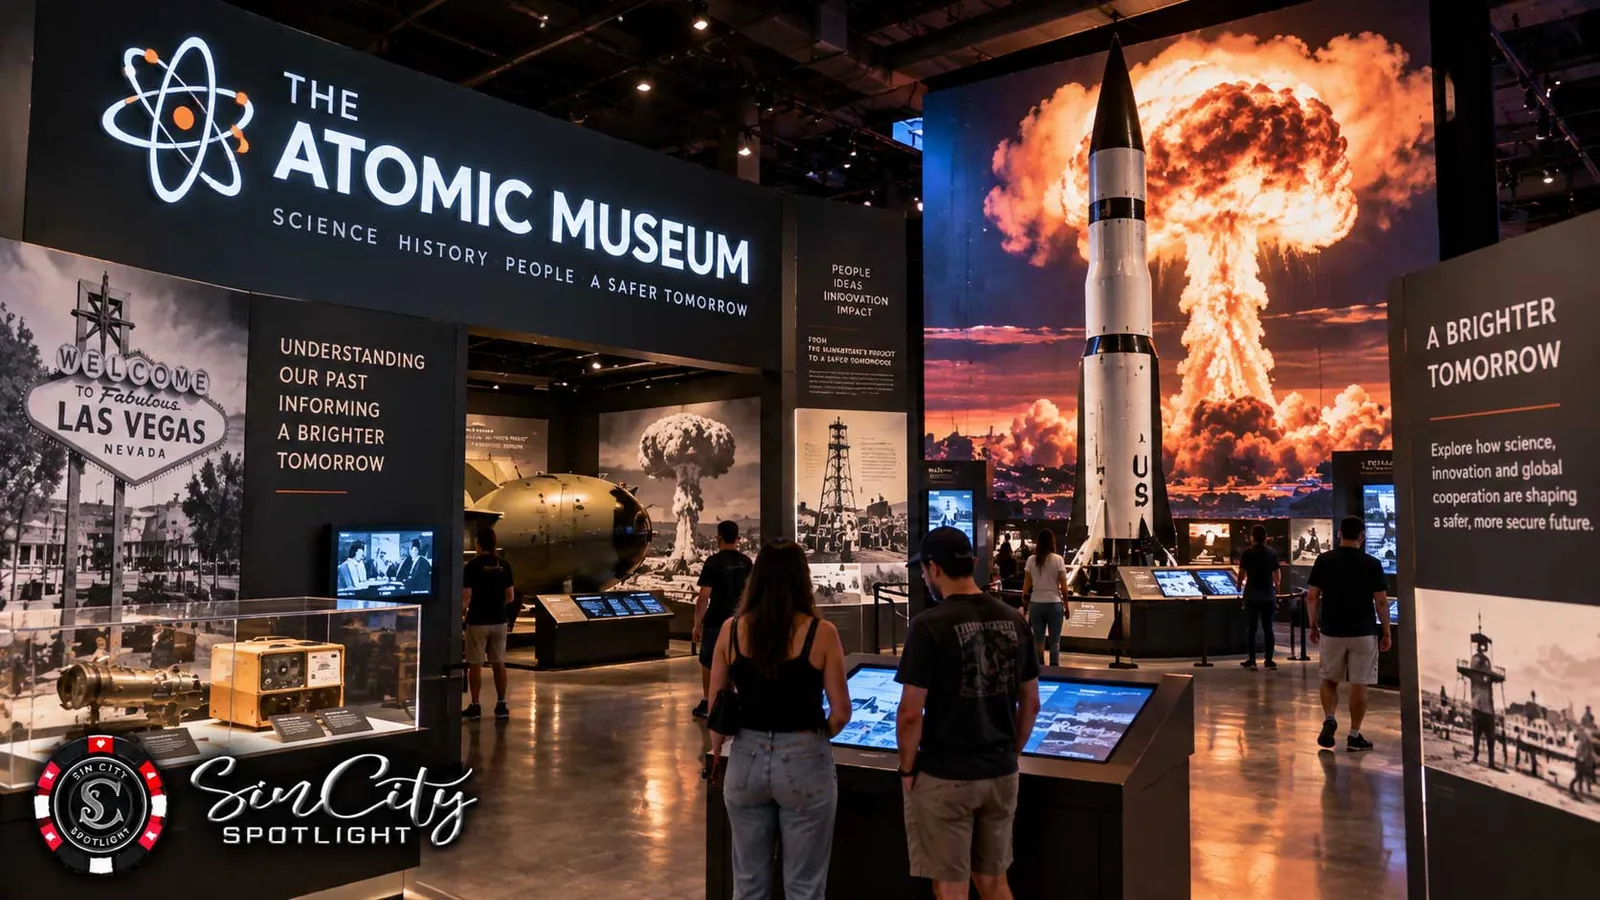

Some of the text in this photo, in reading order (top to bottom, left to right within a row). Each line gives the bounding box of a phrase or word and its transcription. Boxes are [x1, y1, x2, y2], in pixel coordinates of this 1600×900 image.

[283, 71, 358, 121] THE
[273, 120, 749, 285] ATOMIC MUSEUM
[272, 207, 749, 317] SCIENCE HISTORY PEOPLE A SAFER TOMORROW
[832, 264, 871, 278] PEOPLE
[833, 278, 863, 291] IDEAS
[837, 305, 873, 317] IMPACT
[1426, 296, 1557, 350] A BRIGHTER
[280, 337, 426, 370] UNDERSTANDING
[1427, 340, 1561, 388] TOMORROW
[59, 349, 207, 391] WELCOME
[279, 366, 368, 390] OUR PAST
[75, 385, 181, 411] TO Fabulous
[278, 395, 380, 418] INFORMING
[57, 401, 205, 444] LAS VEGAS
[277, 423, 385, 445] A BRIGHTER
[104, 443, 166, 459] NEVADA
[1431, 435, 1556, 459] Explore how science,
[277, 452, 385, 472] TOMORROW
[1432, 459, 1562, 480] innovation and global
[1433, 486, 1577, 507] cooperation are shaping
[1433, 513, 1594, 531] a safer, more secure future.
